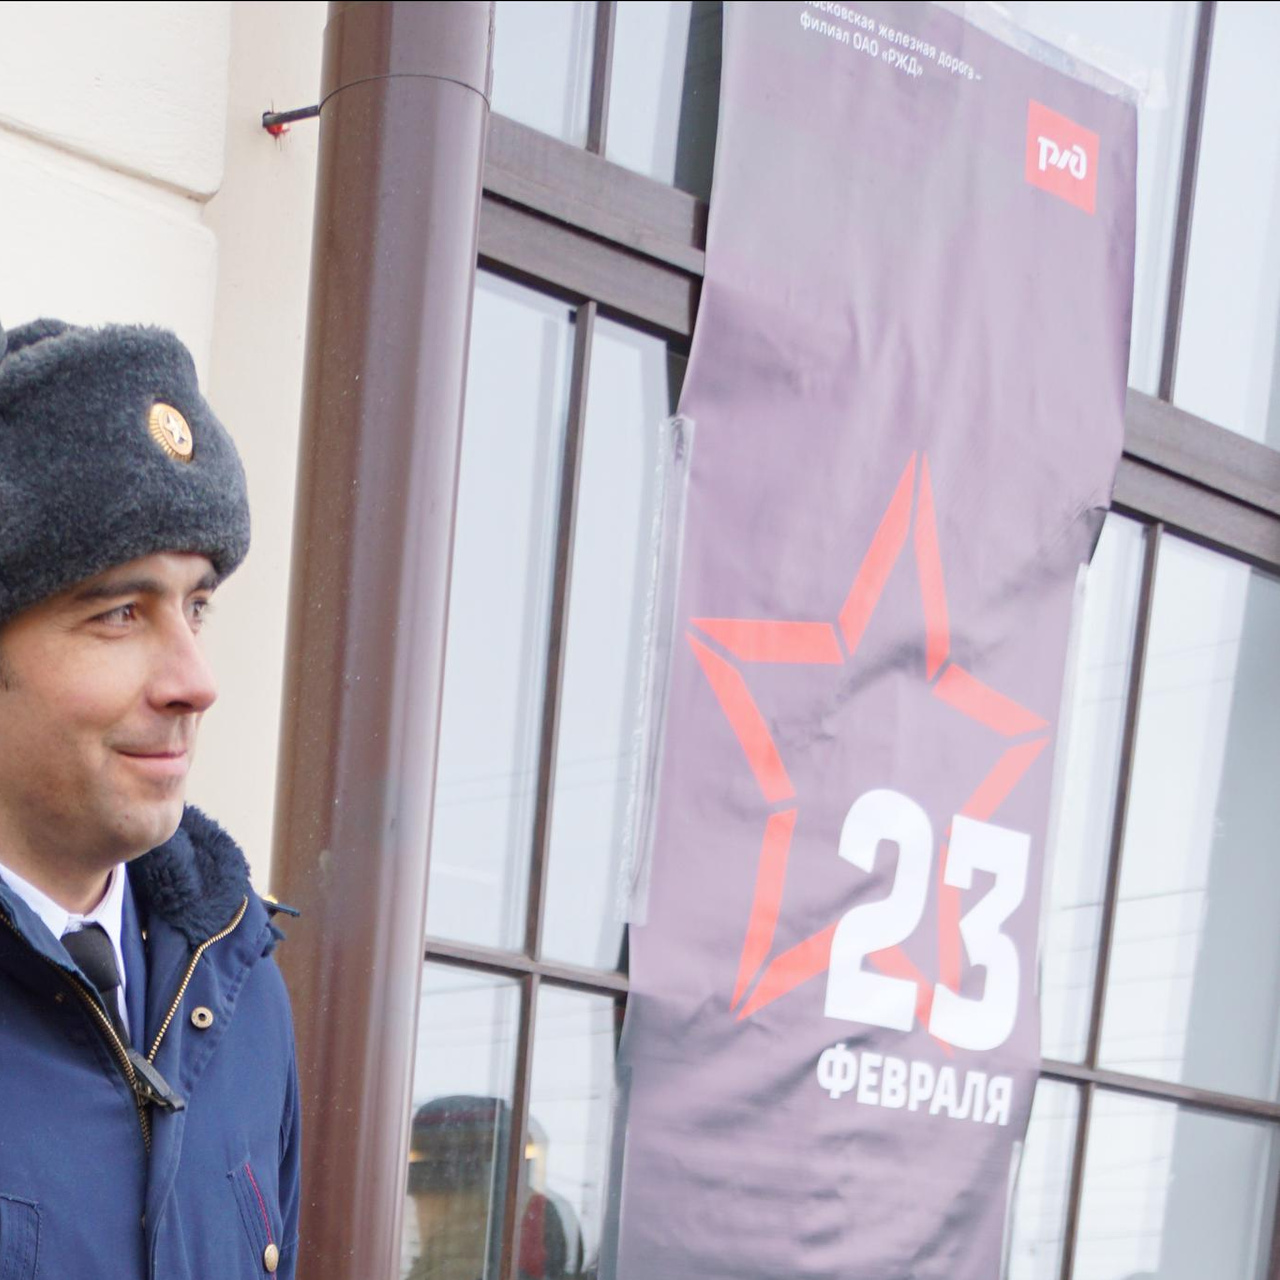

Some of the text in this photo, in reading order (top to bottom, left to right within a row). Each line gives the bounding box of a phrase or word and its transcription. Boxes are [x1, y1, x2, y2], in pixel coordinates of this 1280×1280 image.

[800, 10, 923, 78] филиал ОАО «РЖД»
[878, 22, 936, 59] железная
[937, 51, 974, 80] дорога
[824, 788, 1031, 1051] 23
[816, 1043, 1013, 1126] ФЕВРАЛЯ
